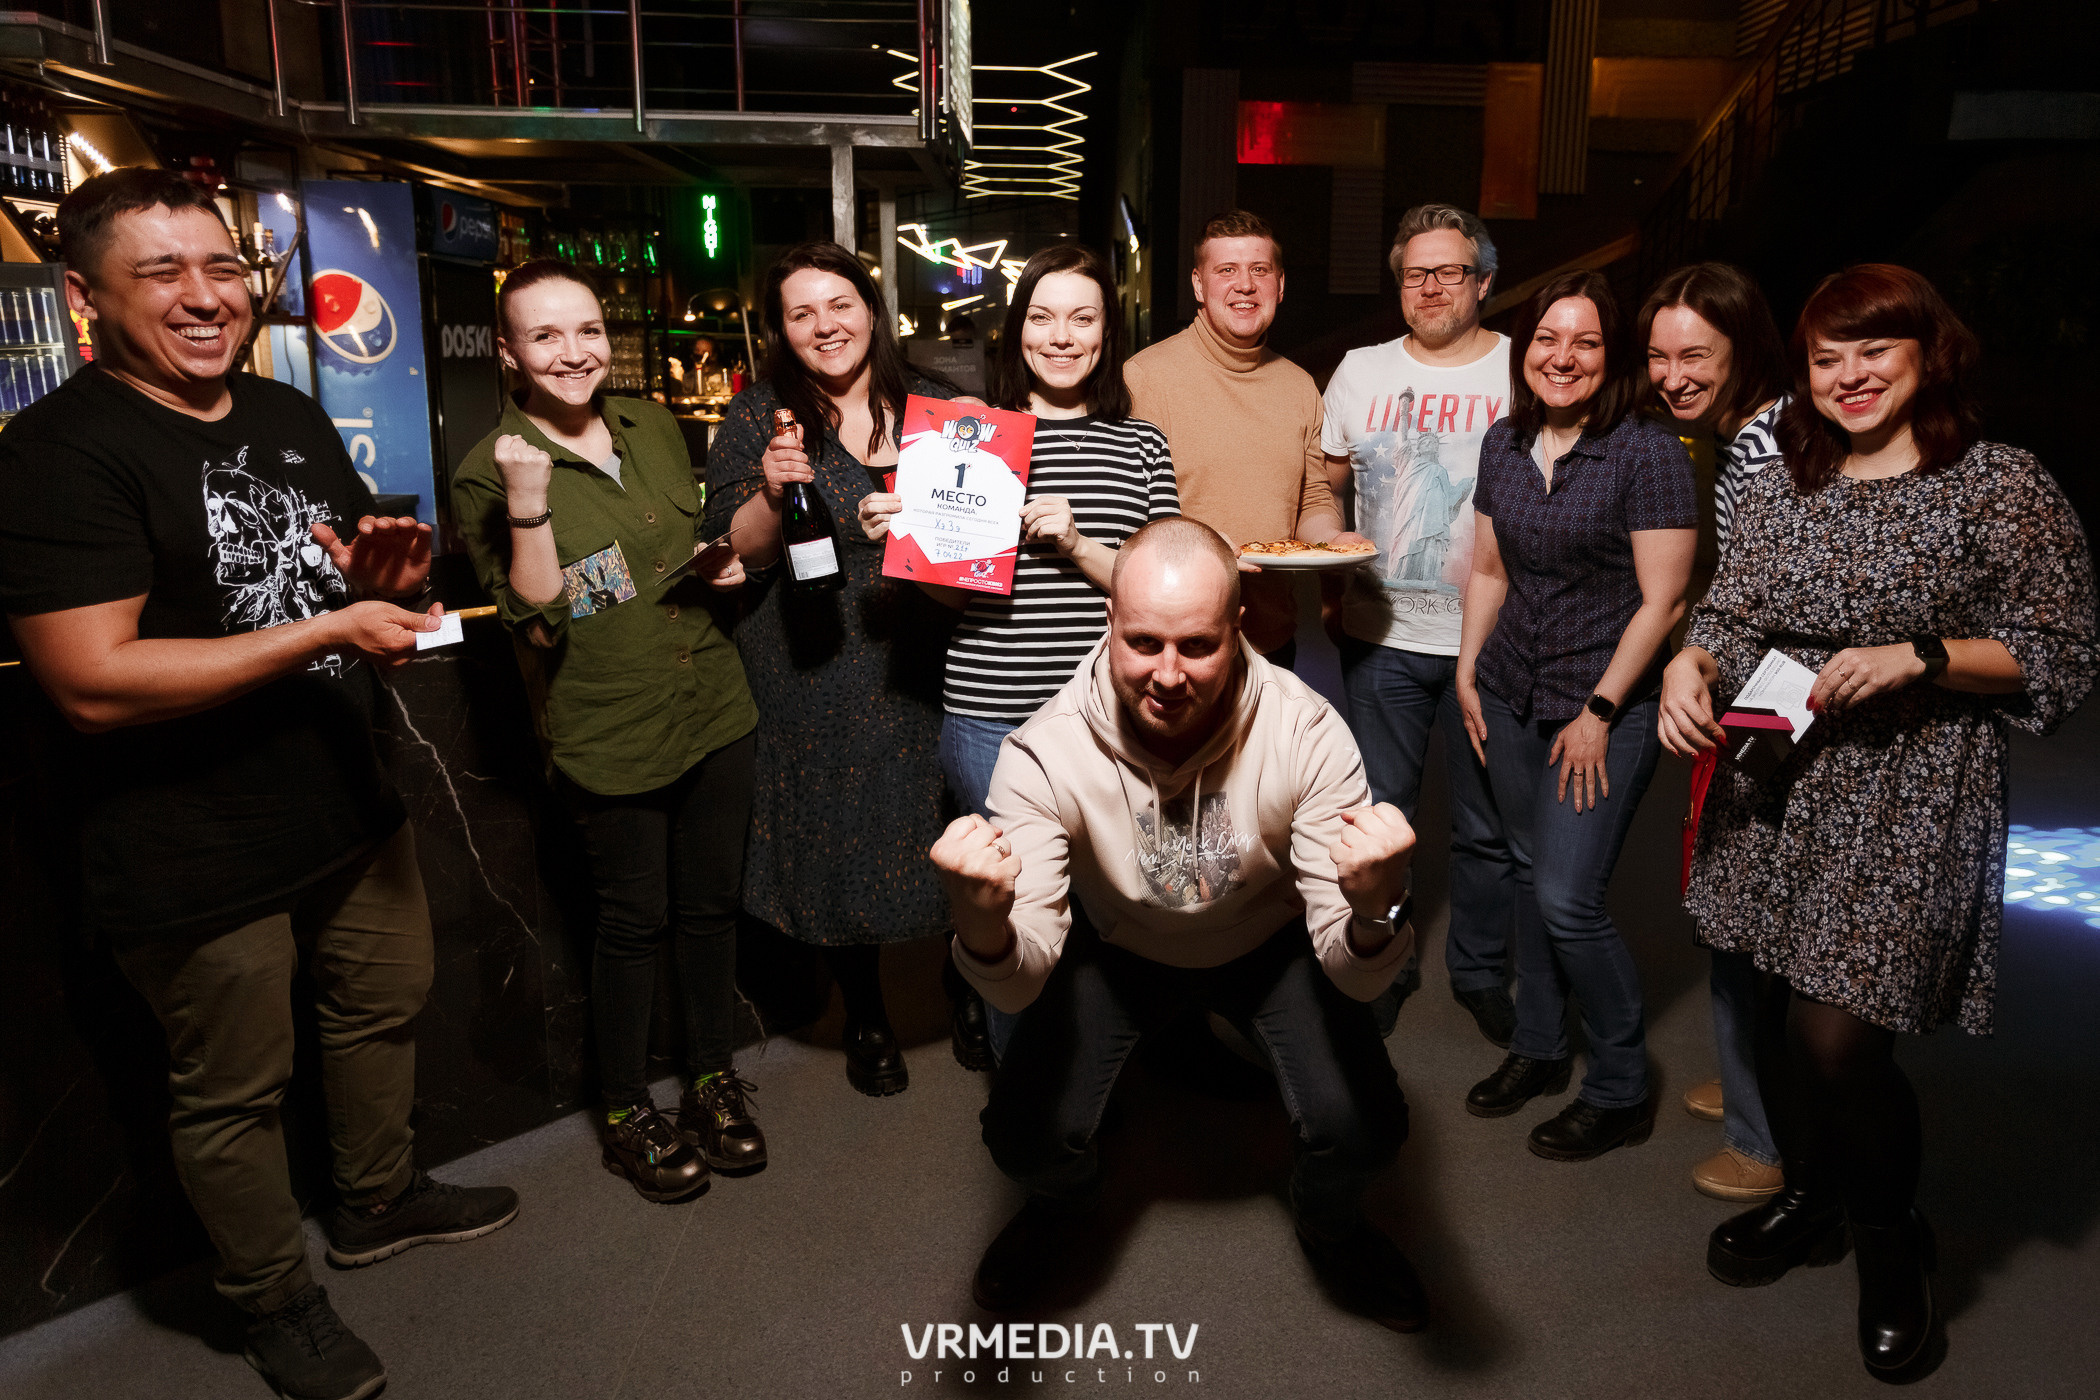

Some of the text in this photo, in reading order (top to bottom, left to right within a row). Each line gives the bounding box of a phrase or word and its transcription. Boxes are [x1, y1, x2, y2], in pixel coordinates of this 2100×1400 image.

[441, 324, 493, 358] DOSKI
[1366, 394, 1503, 432] LIBERTY
[950, 437, 980, 453] QUIZ
[955, 463, 966, 488] 1
[931, 488, 987, 507] МЕСТО
